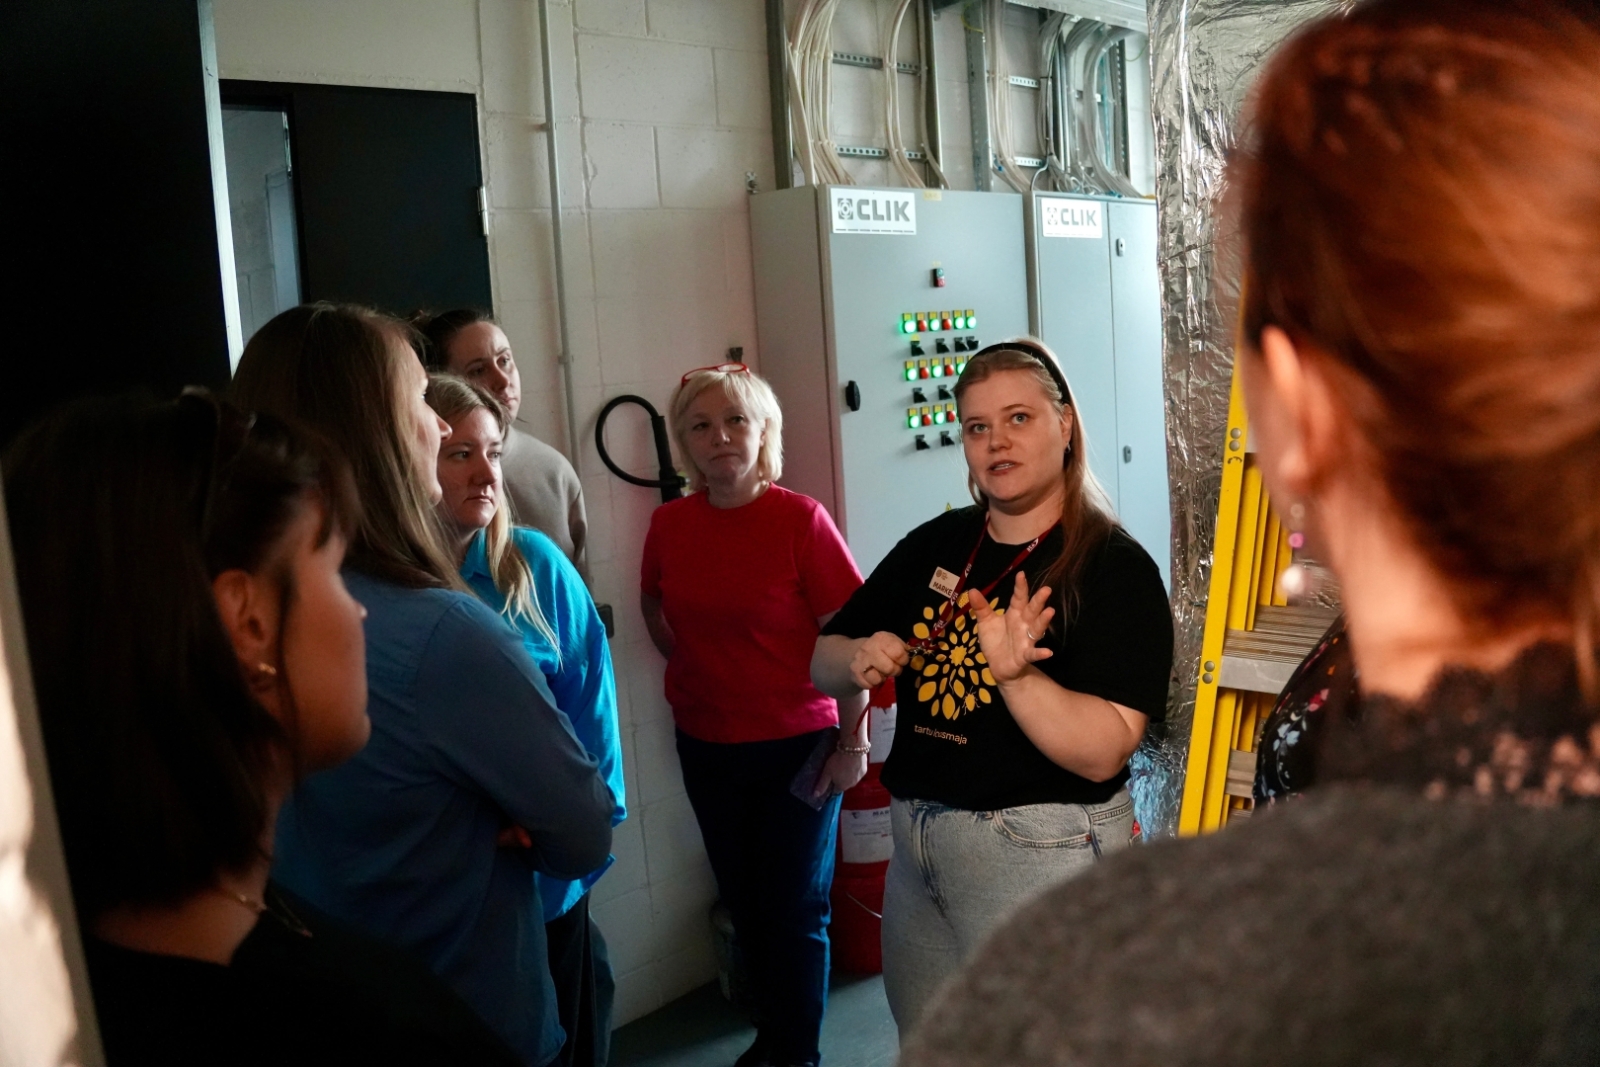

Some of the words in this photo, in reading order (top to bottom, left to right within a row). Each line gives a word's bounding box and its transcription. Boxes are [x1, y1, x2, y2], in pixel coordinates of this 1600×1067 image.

[856, 198, 910, 222] CLIK
[1060, 208, 1097, 226] CLIK
[914, 724, 933, 736] tartu
